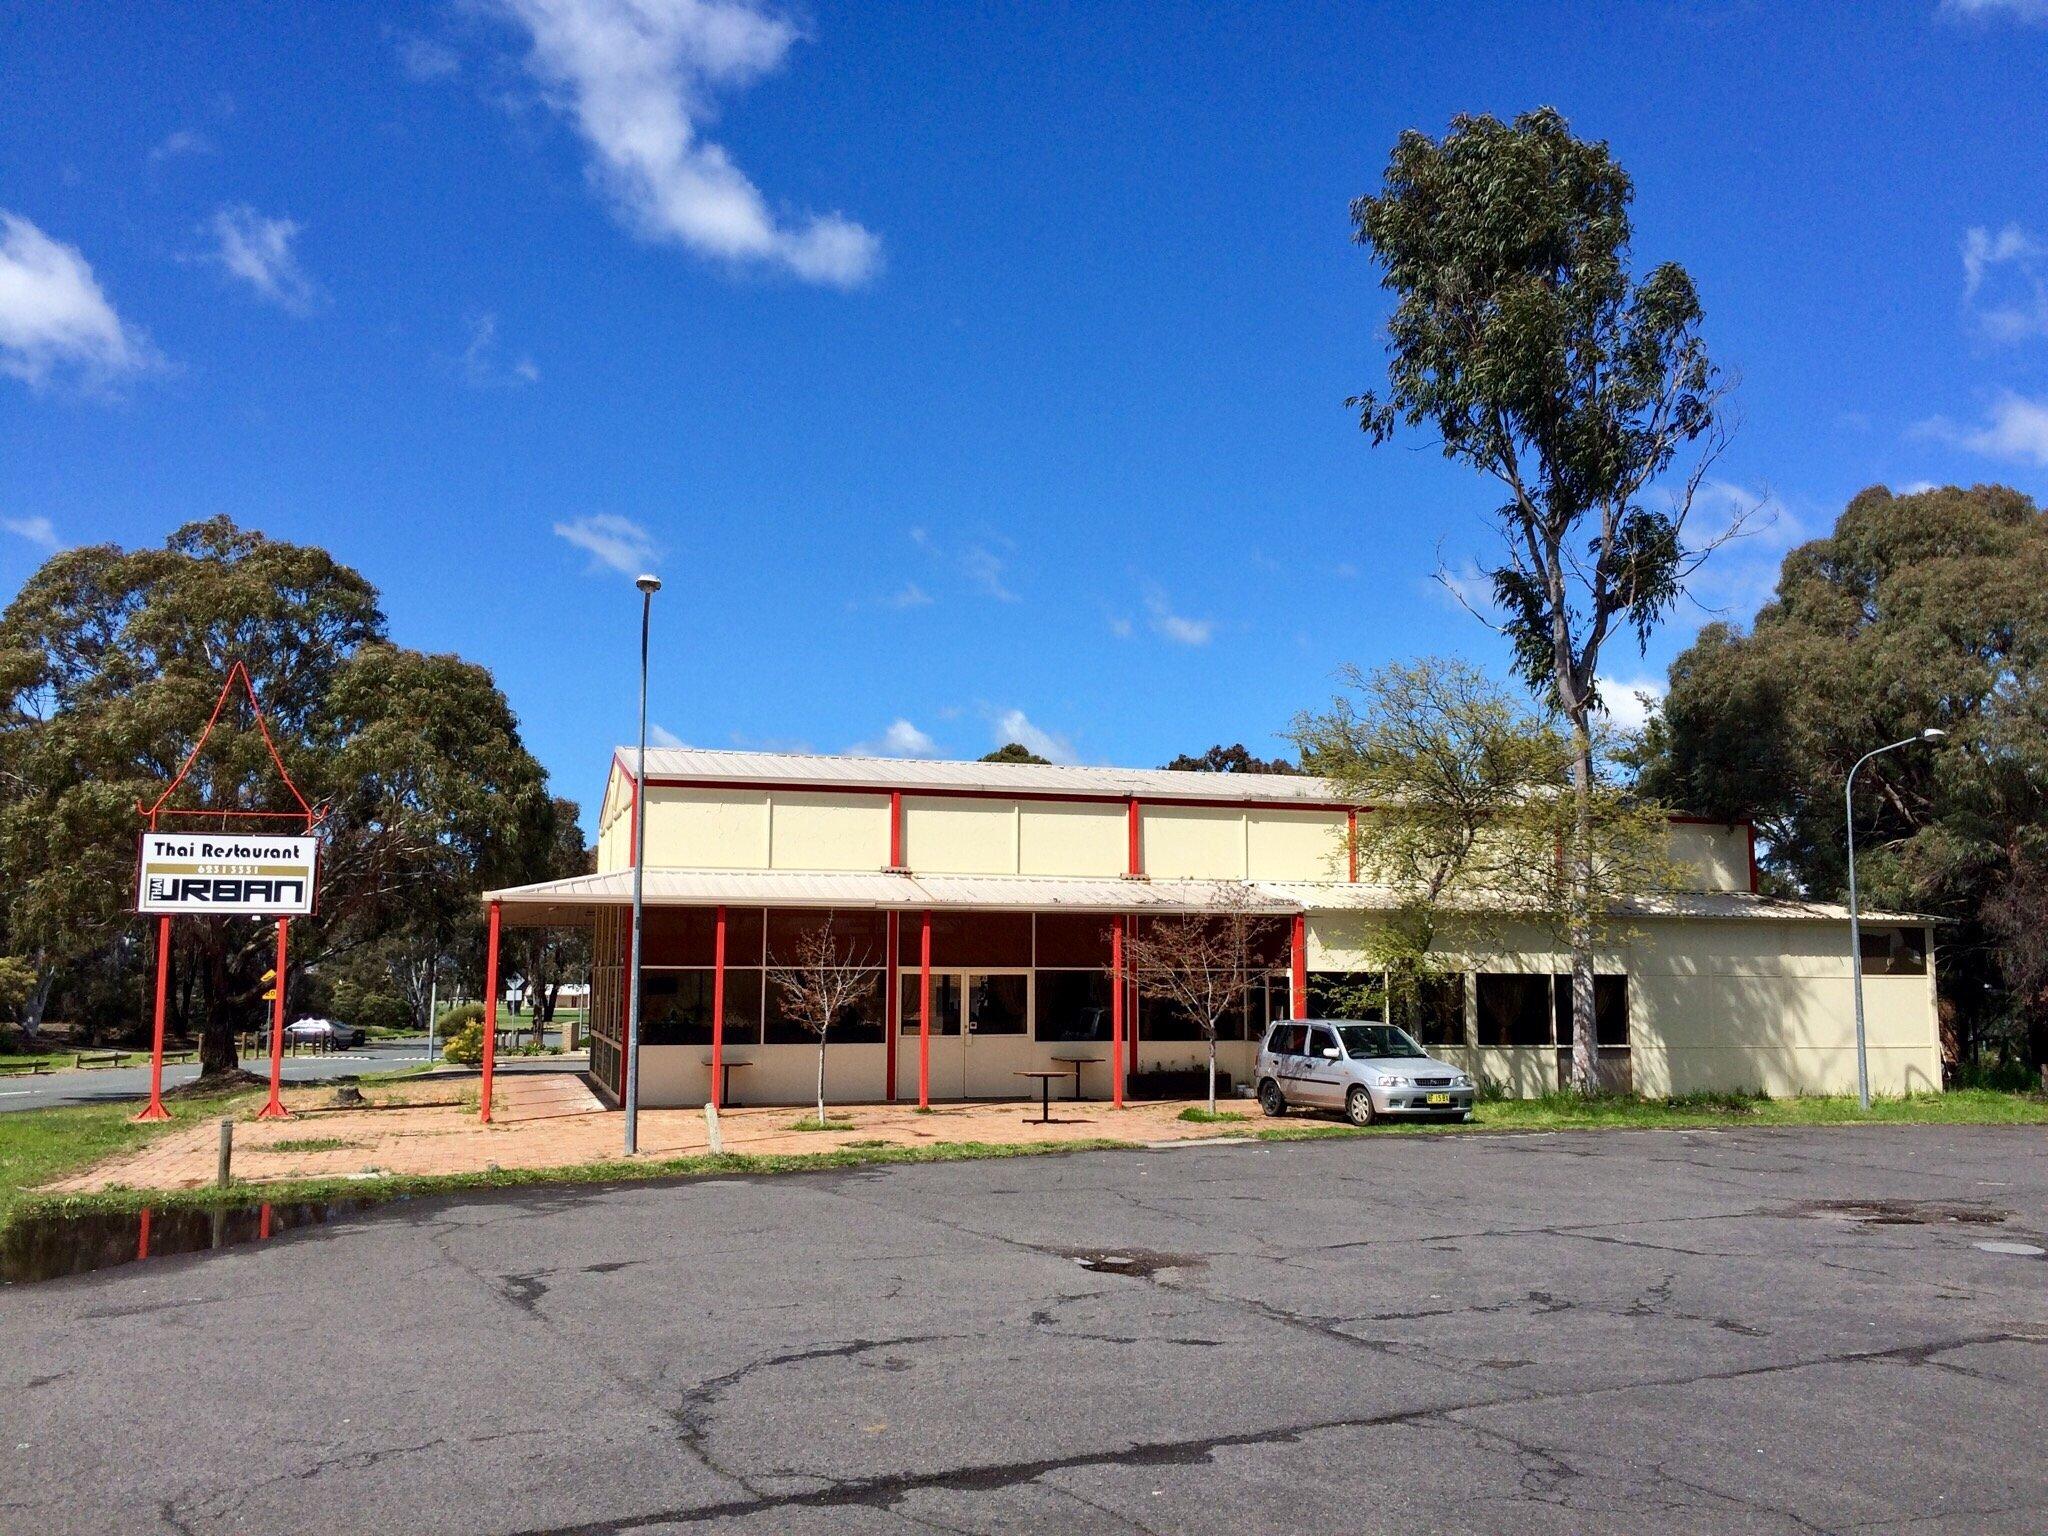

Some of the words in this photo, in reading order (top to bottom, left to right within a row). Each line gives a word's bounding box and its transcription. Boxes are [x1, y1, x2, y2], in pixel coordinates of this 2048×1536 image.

[154, 842, 195, 857] Thai
[202, 843, 300, 859] Restaurant
[149, 878, 303, 902] URBAN
[151, 878, 163, 901] THAI
